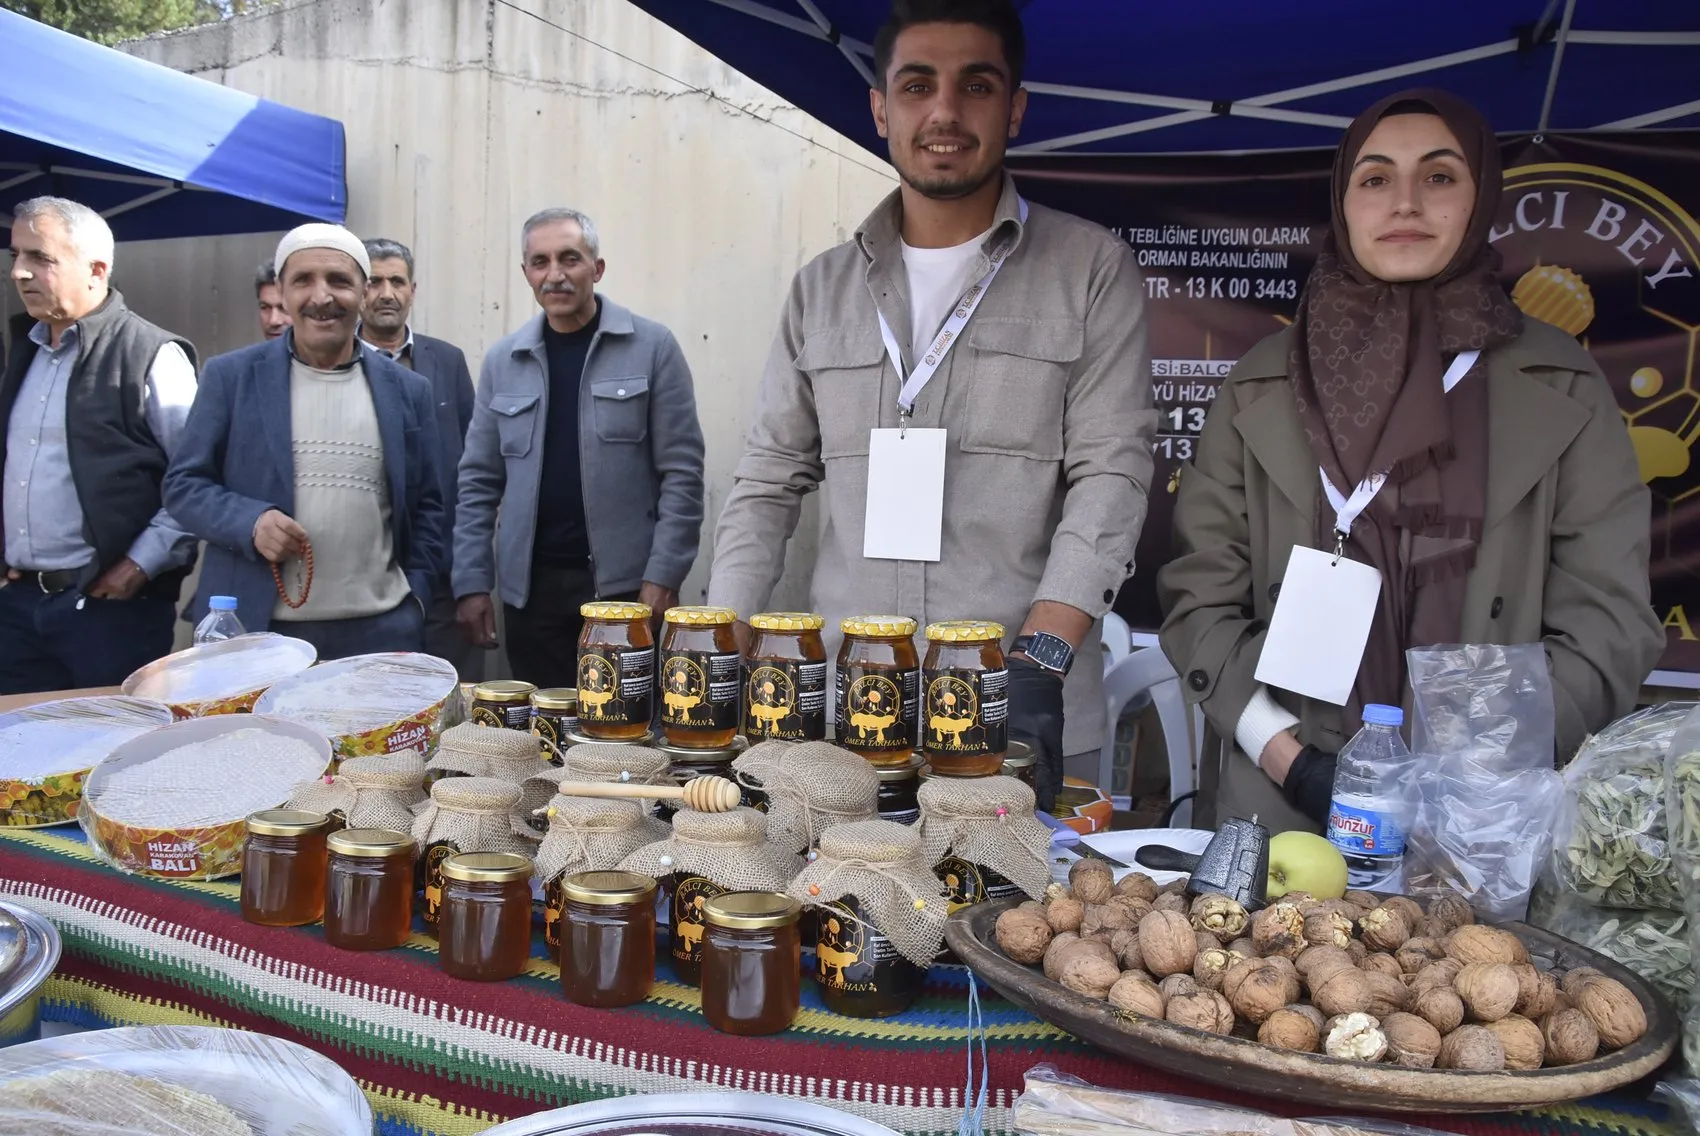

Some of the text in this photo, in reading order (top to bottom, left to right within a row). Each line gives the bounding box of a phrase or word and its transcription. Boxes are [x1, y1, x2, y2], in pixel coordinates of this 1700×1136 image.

[1129, 225, 1198, 246] TEBLİĞİNE
[1201, 228, 1249, 246] UYGUN
[1252, 226, 1310, 246] OLARAK
[1584, 198, 1693, 290] BEY
[1138, 248, 1288, 269] ORMAN BAKANLIĞININ
[1186, 276, 1206, 299] 13
[1211, 277, 1224, 299] K
[1228, 277, 1250, 299] 00
[1254, 278, 1297, 299] 3443
[1151, 361, 1234, 376] Sİ:BALC
[1179, 381, 1222, 401] HİZA
[388, 725, 426, 746] HİZAN
[868, 739, 902, 747] TARHAN
[945, 743, 980, 751] TARHAN
[148, 841, 196, 853] HİZAN
[151, 858, 197, 872] BALI
